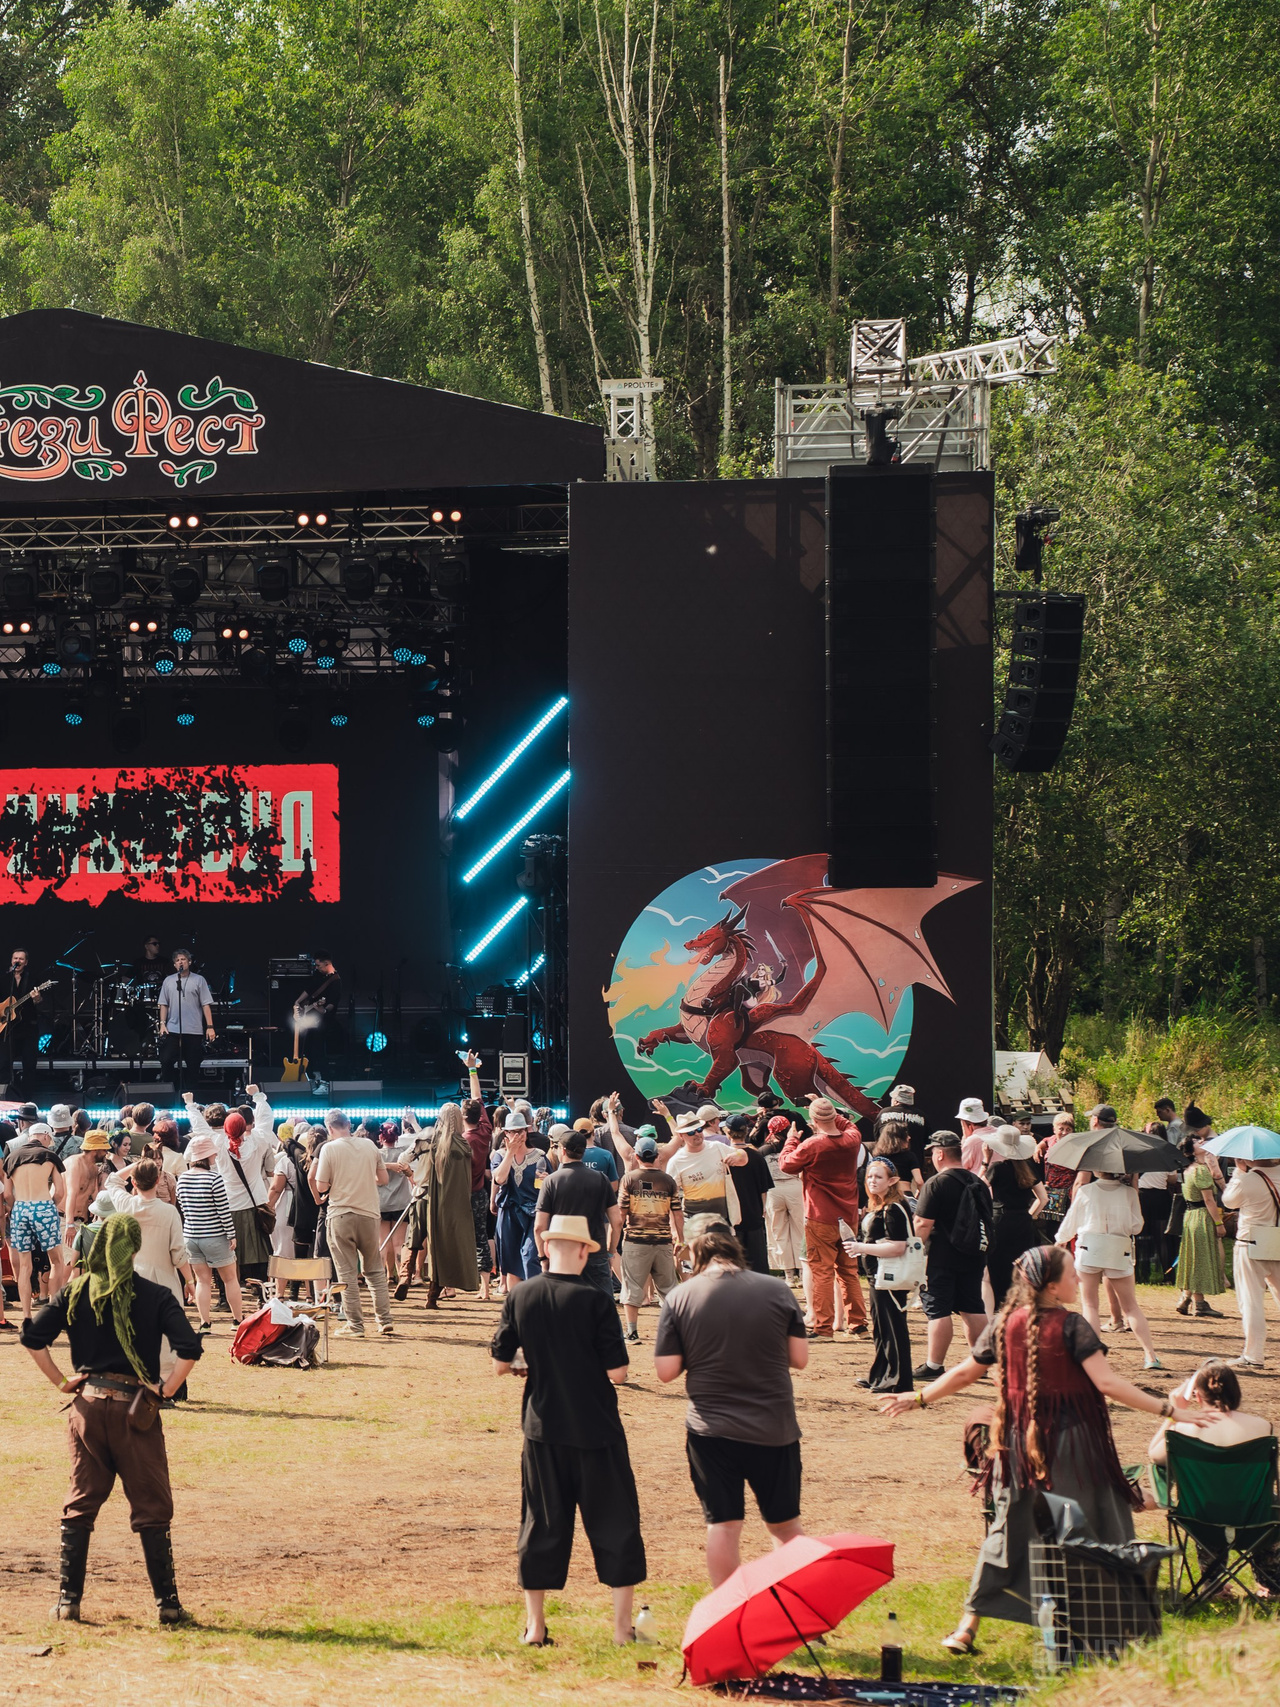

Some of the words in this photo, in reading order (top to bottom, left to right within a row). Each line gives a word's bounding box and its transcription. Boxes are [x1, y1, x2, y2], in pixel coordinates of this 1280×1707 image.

[623, 381, 655, 389] PROLYTE
[112, 371, 266, 458] Фест
[583, 1161, 598, 1169] ЧС
[633, 1189, 669, 1199] PIRATE
